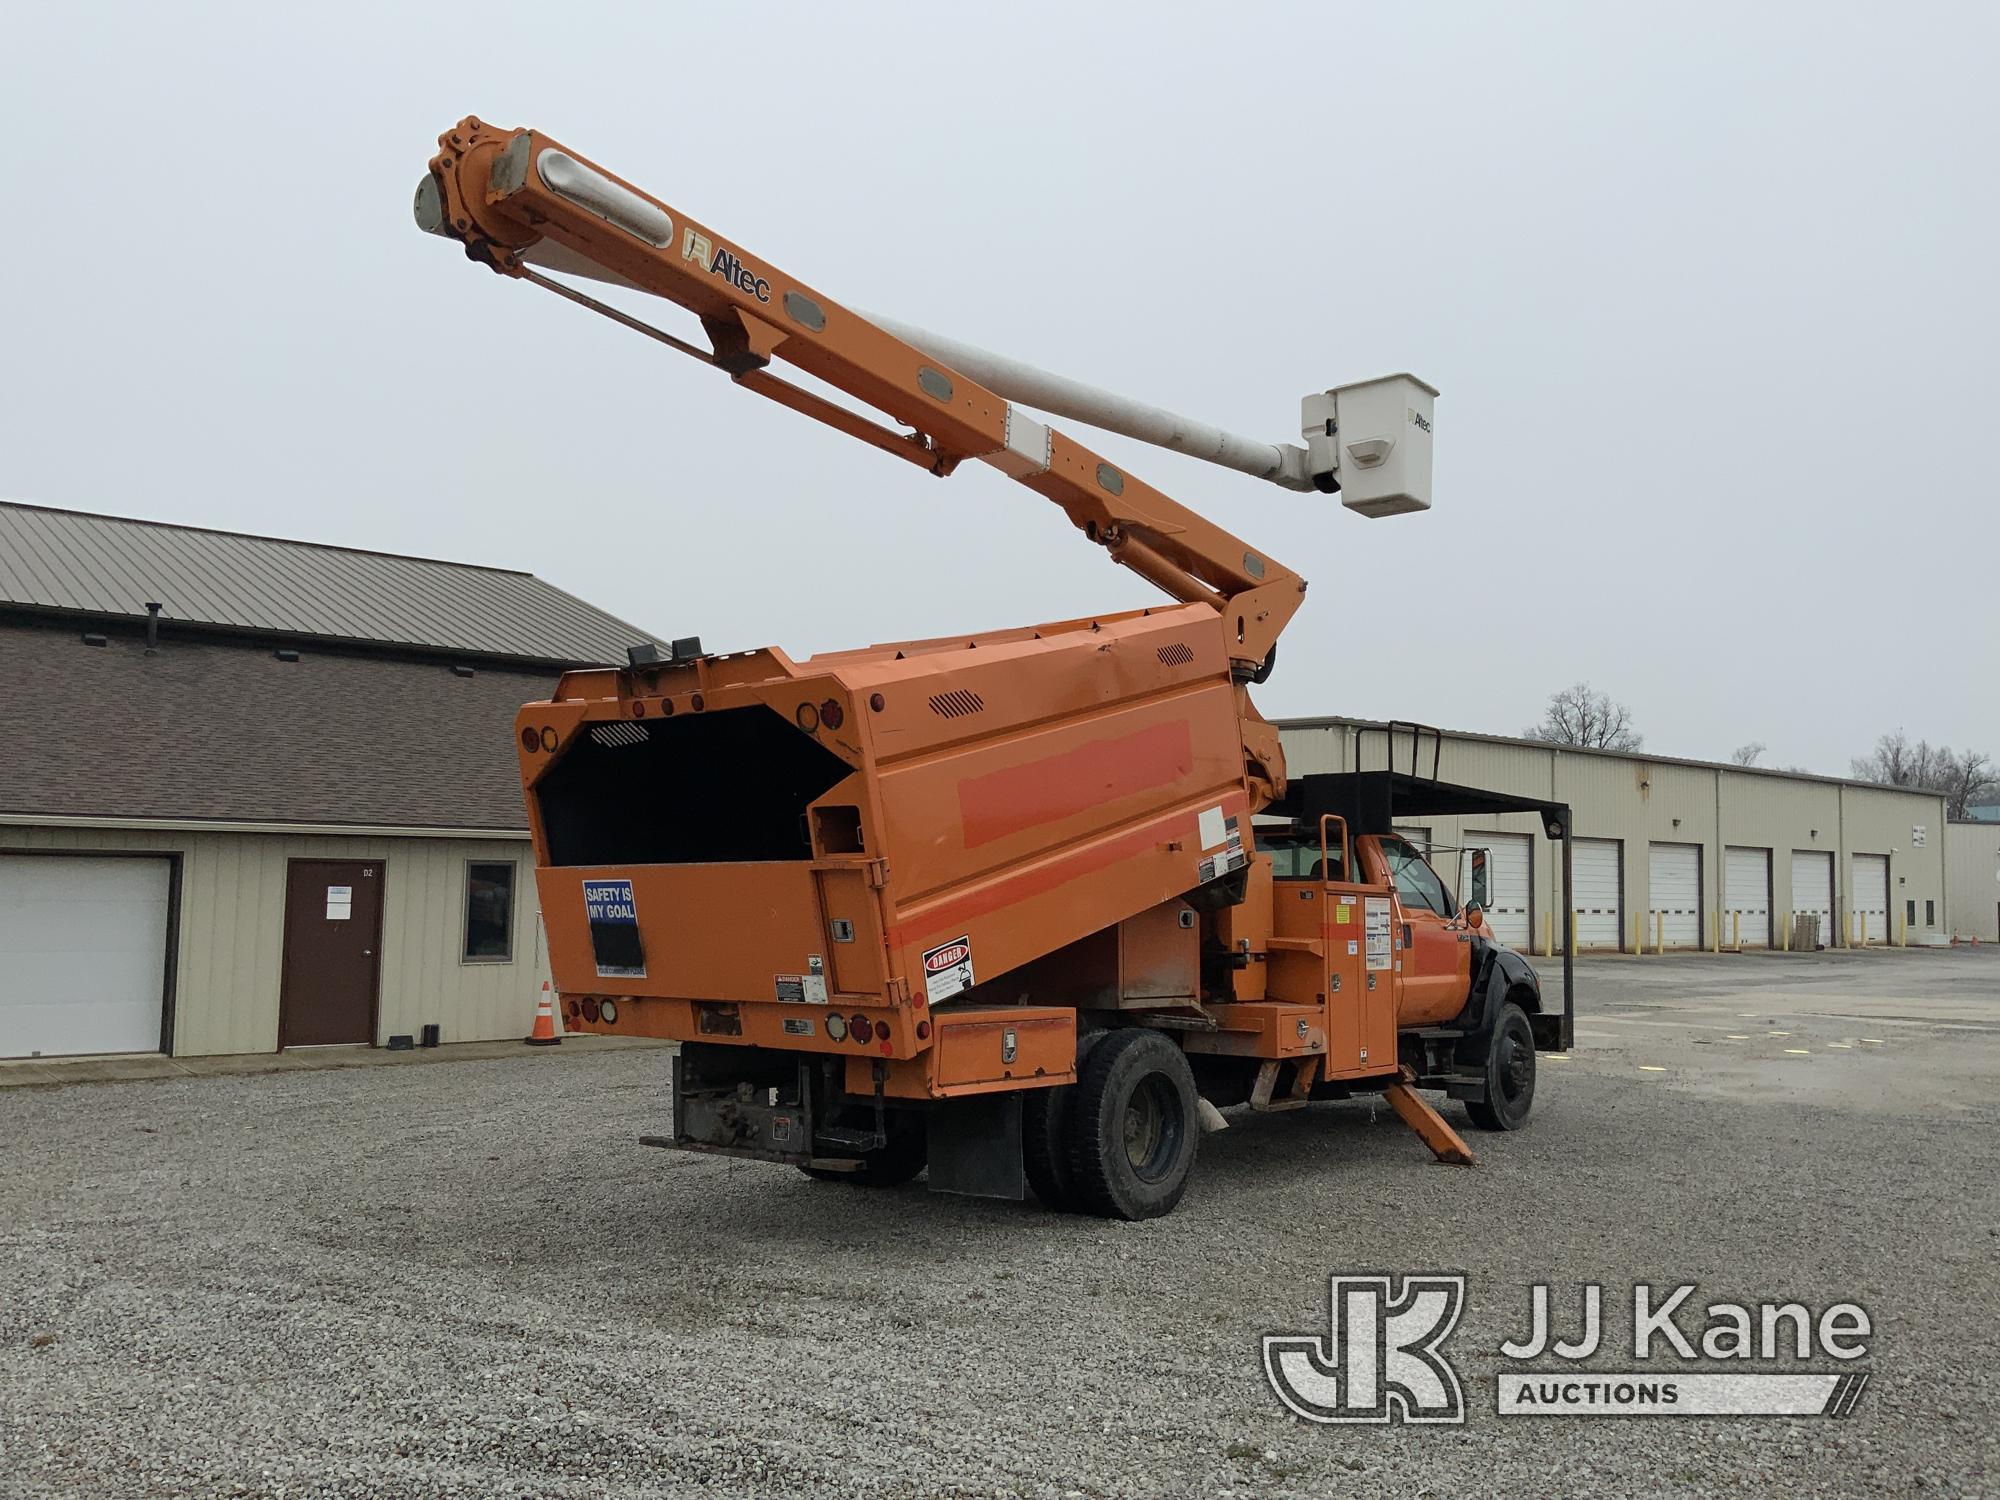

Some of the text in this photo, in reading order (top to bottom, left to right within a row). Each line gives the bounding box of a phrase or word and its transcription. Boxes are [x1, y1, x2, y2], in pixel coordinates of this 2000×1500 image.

[710, 247, 770, 303] Altec
[1415, 412, 1430, 433] Altec
[363, 869, 373, 877] D2
[586, 887, 631, 901] SAFETY IS
[589, 904, 634, 918] MY GOAL
[932, 947, 962, 968] DANGER
